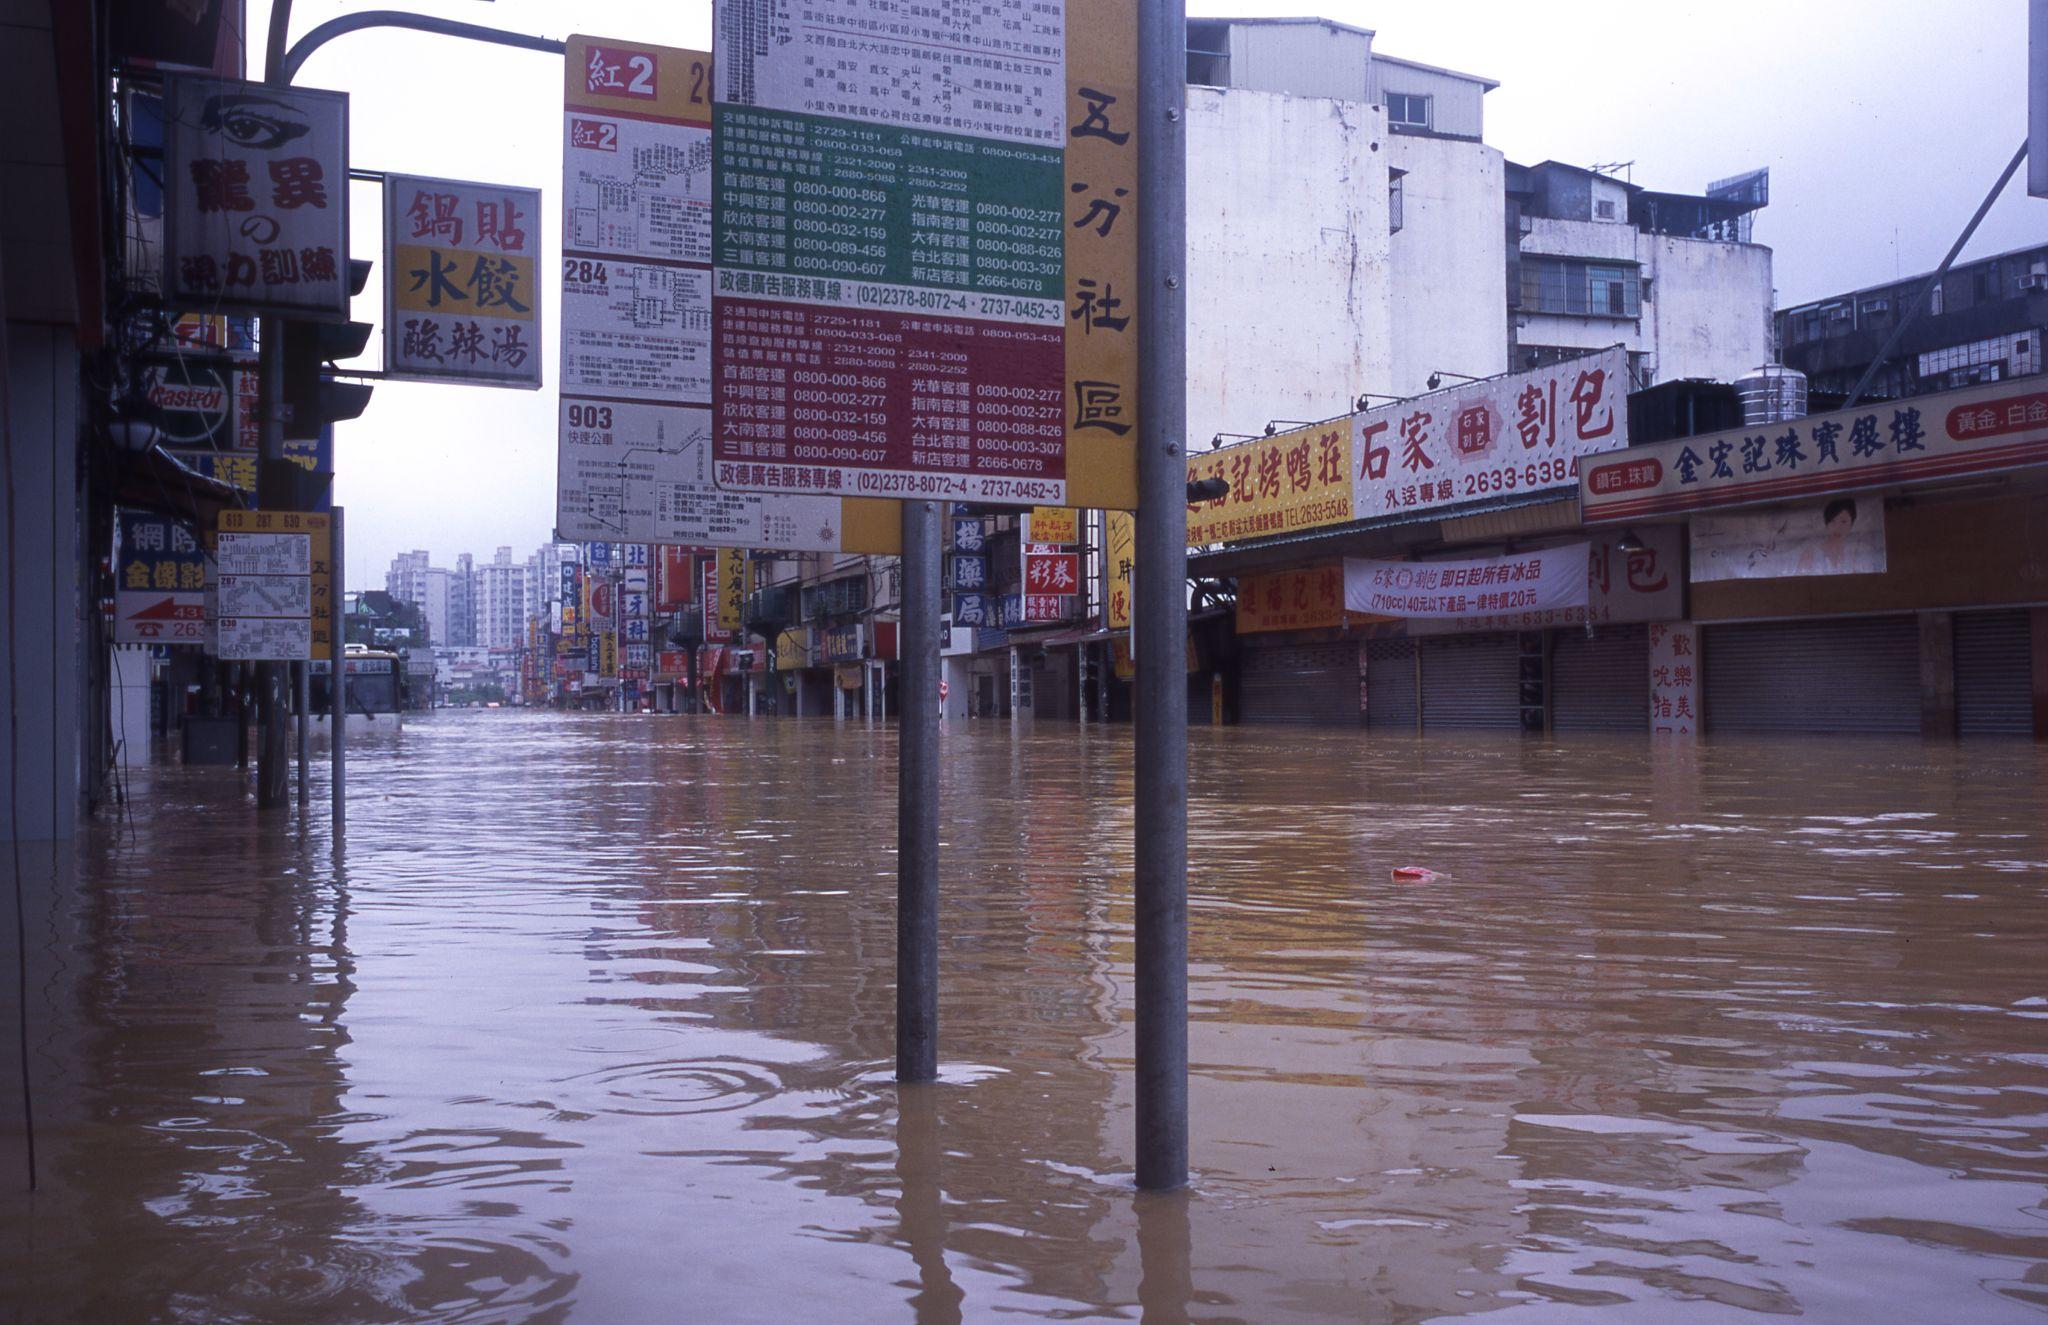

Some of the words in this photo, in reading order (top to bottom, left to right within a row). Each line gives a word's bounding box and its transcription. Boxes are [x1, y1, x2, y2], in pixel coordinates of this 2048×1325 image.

[588, 49, 653, 95] 紅2
[573, 120, 615, 150] 紅2
[723, 172, 786, 193] 首都客運
[793, 181, 886, 202] 0800-000-866
[406, 190, 525, 250] 鍋貼
[723, 192, 786, 212] 中興客運
[793, 200, 886, 221] 0800-002-277
[912, 194, 970, 214] 光華客運
[976, 202, 1061, 223] 0800-002-277
[723, 210, 786, 231] 欣欣客運
[793, 218, 886, 240] 0800-032-159
[912, 212, 970, 232] 指南客運
[976, 221, 1061, 241] 0800-002-277
[723, 229, 786, 249] 大南客運
[793, 237, 886, 258] 0800-089-456
[912, 230, 970, 250] 大有客運
[976, 238, 1061, 258] 0800-088-626
[564, 259, 608, 285] 284
[723, 248, 786, 268] 三重客運
[793, 256, 886, 276] 0800-090-607
[912, 249, 970, 268] 台北客運
[976, 256, 1061, 275] 0800-003-307
[409, 250, 530, 313] 水餃
[912, 267, 970, 285] 新店客運
[976, 274, 1042, 292] 2666-0678
[403, 318, 529, 369] 酸辣湯
[723, 365, 786, 382] 首都客運
[793, 370, 886, 389] 0800-000-866
[912, 378, 970, 396] 光華客運
[976, 384, 1061, 402] 0800-002-277
[150, 386, 223, 410] Castrol
[723, 384, 786, 402] 中興客運
[793, 389, 886, 407] 0800-002-277
[912, 396, 970, 414] 指南客運
[976, 402, 1061, 419] 0800-002-277
[568, 404, 612, 429] 903
[723, 402, 786, 420] 欣欣客運
[793, 407, 886, 426] 0800-032-159
[912, 415, 970, 432] 大有客運
[976, 420, 1061, 437] 0800-088-626
[723, 421, 786, 439] 大南客運
[793, 426, 886, 444] 0800-089-456
[912, 433, 970, 450] 台北客運
[976, 438, 1061, 455] 0800-003-307
[1360, 410, 1434, 481] 石家
[1674, 407, 1926, 485] 金宏記珠寶銀樓
[723, 440, 786, 458] 三重客運
[793, 445, 886, 462] 0800-090-607
[912, 451, 970, 468] 新店客運
[976, 456, 1042, 471] 2666-0678
[1030, 559, 1074, 588] 彩券
